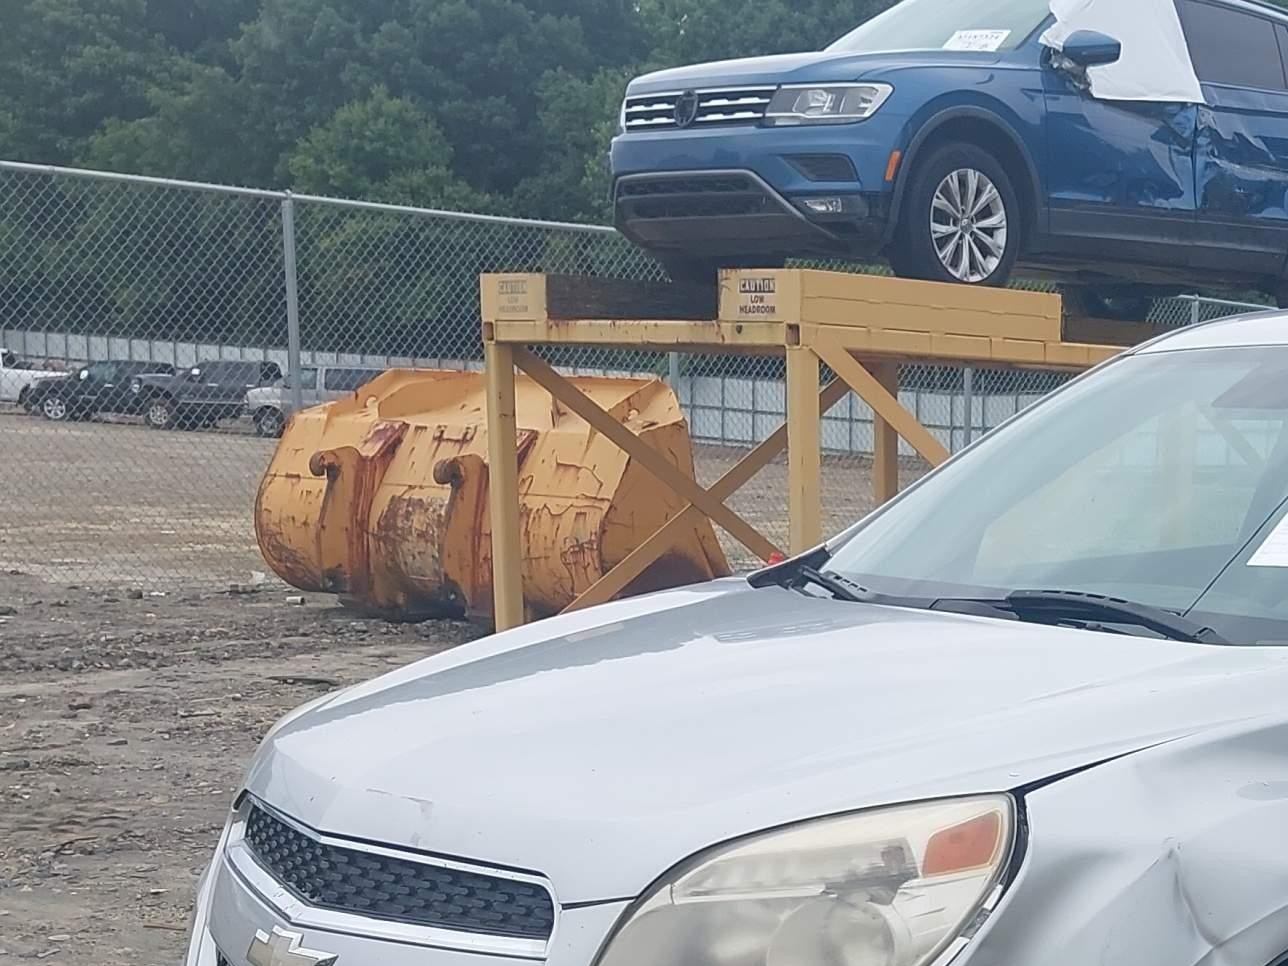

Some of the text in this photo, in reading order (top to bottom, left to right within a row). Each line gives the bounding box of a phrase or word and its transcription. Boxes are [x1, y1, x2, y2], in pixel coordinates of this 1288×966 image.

[740, 279, 775, 292] CAUTION
[751, 295, 764, 303] LOW
[740, 305, 775, 314] HEADROOM
